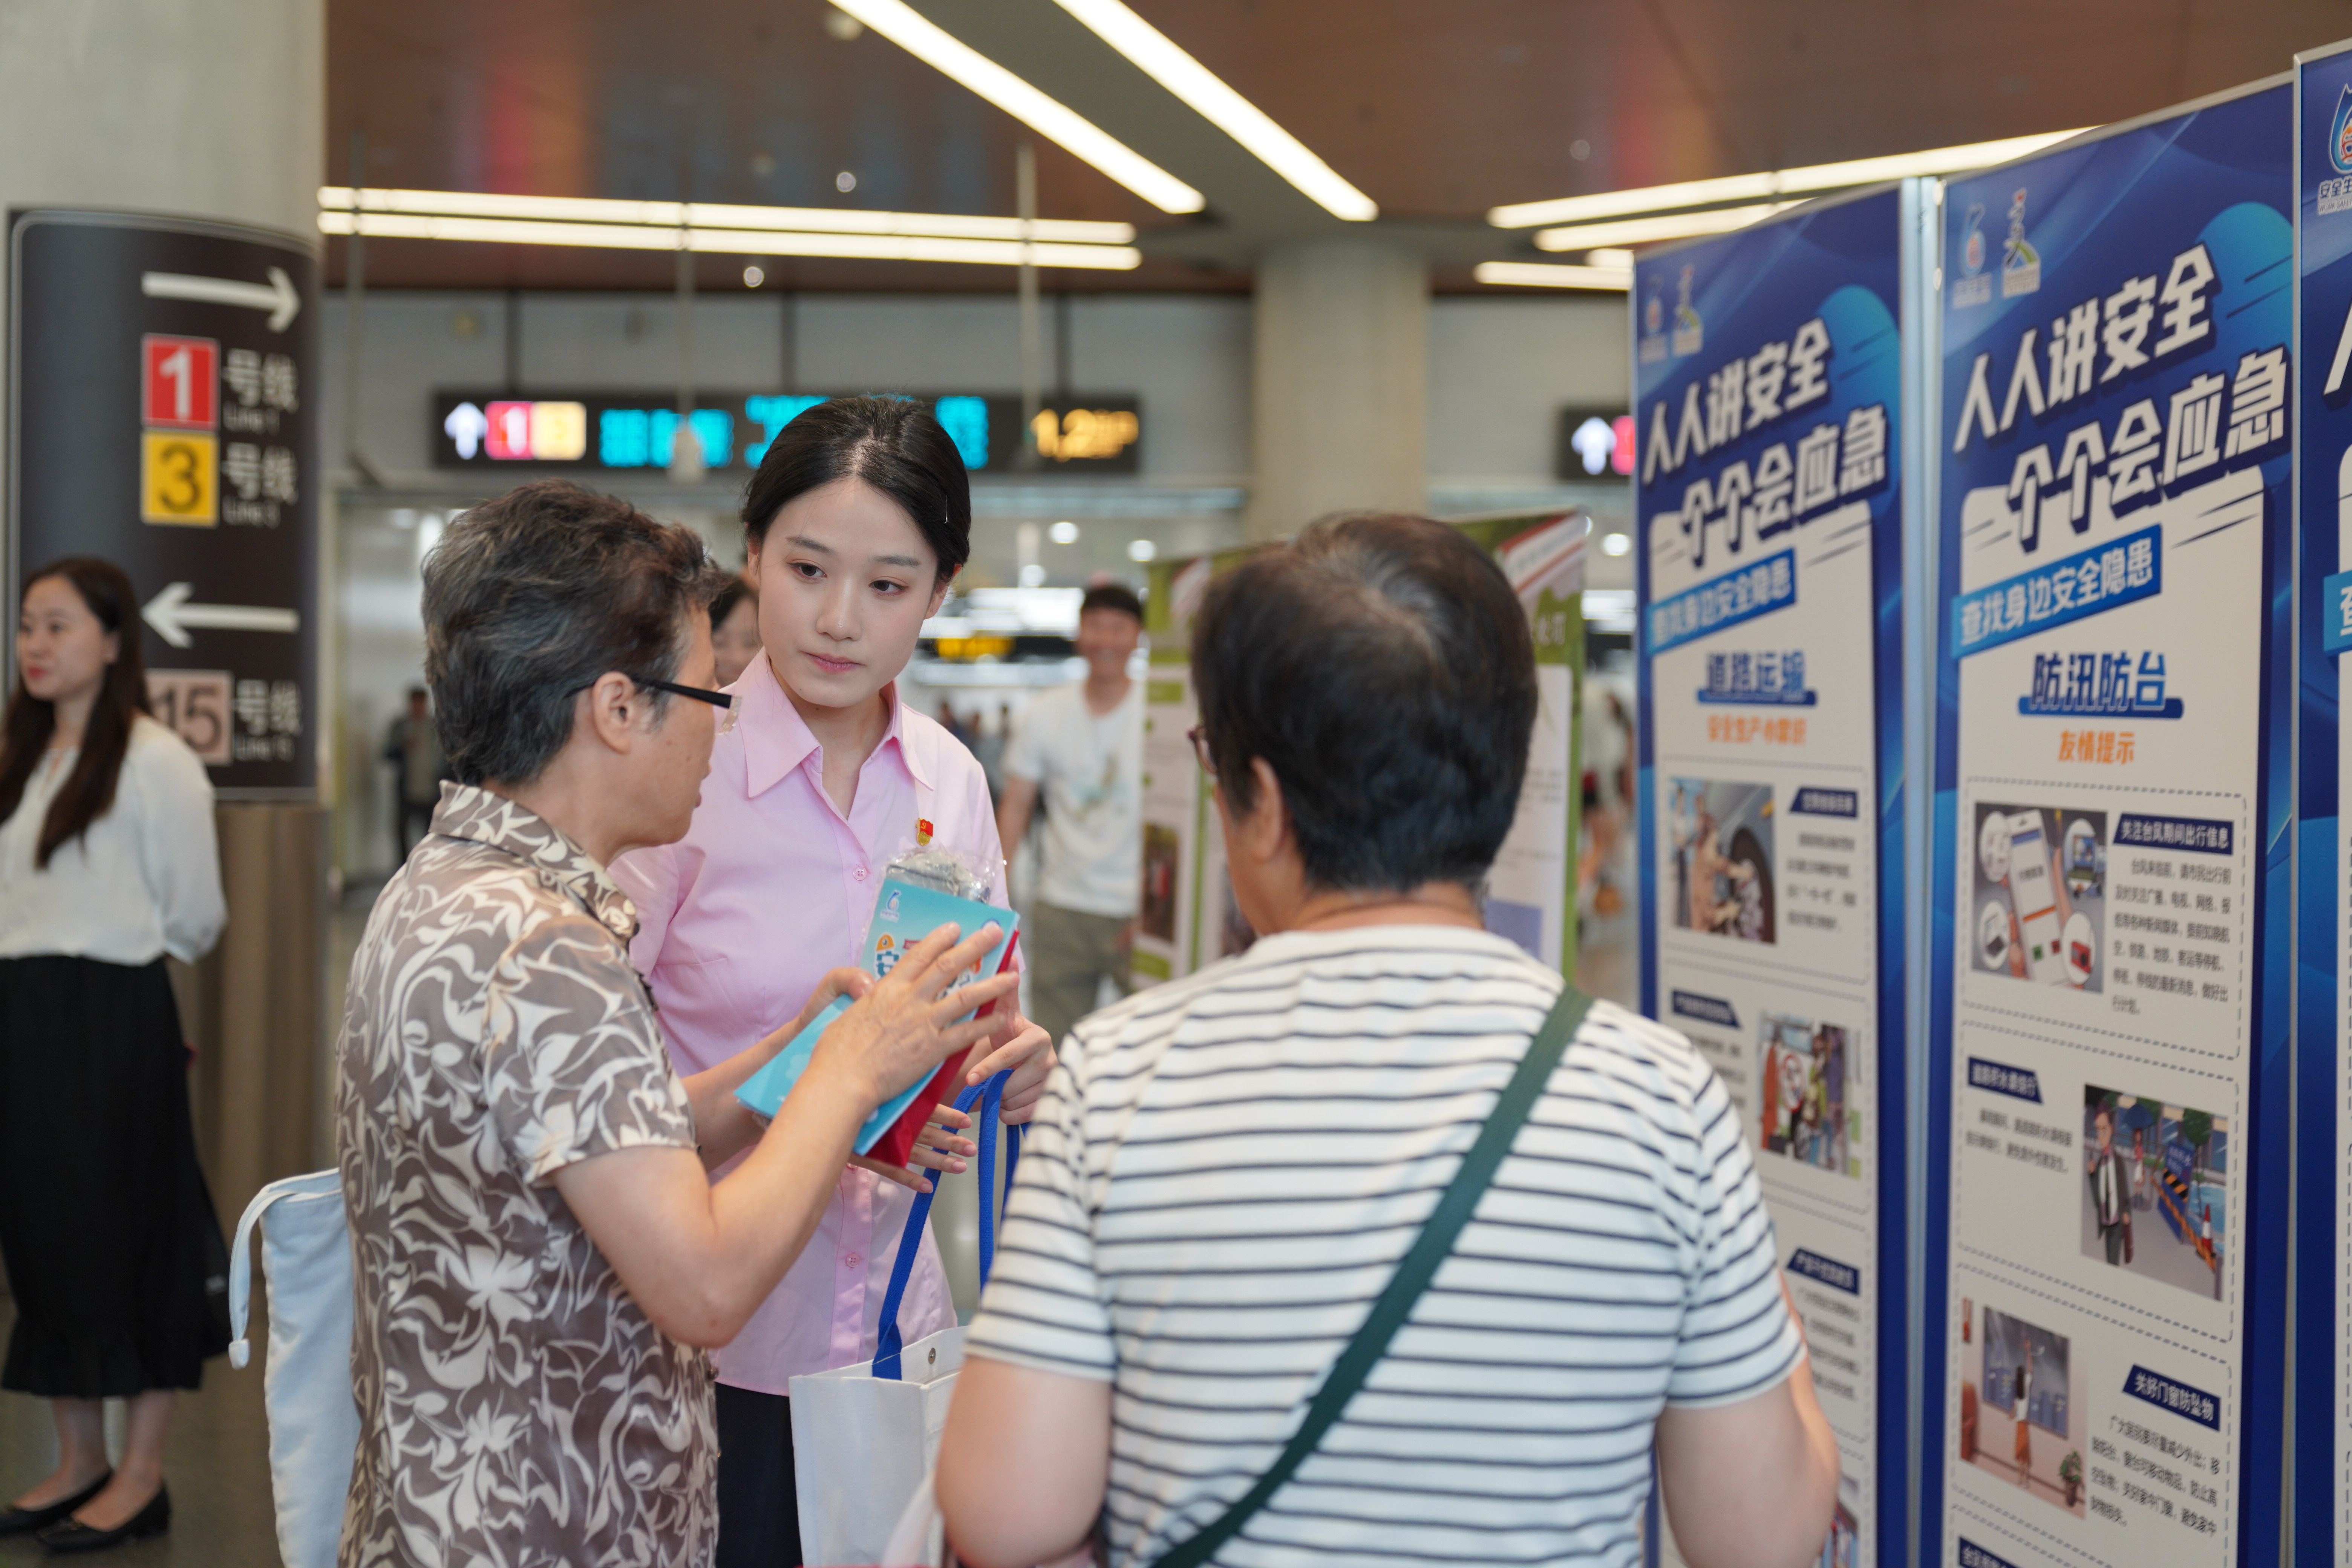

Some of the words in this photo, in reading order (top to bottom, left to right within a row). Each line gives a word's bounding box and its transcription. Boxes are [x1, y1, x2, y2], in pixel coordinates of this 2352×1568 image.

[159, 345, 190, 422] 1
[1953, 243, 2215, 453] 人人讲安全
[1642, 318, 1831, 485] 人人讲安全
[159, 443, 202, 515] 3
[1681, 404, 1885, 561] 个个会应急
[2006, 347, 2287, 547] 个个会应急
[1962, 537, 2153, 648] 查找身边安全隐患
[2030, 651, 2165, 711] 防汛防台
[152, 686, 222, 752] 15
[2058, 730, 2135, 764] 友情提示
[2121, 819, 2229, 850] 关注台风期间出行信息
[2134, 1371, 2214, 1422] 关好门窗防坠物
